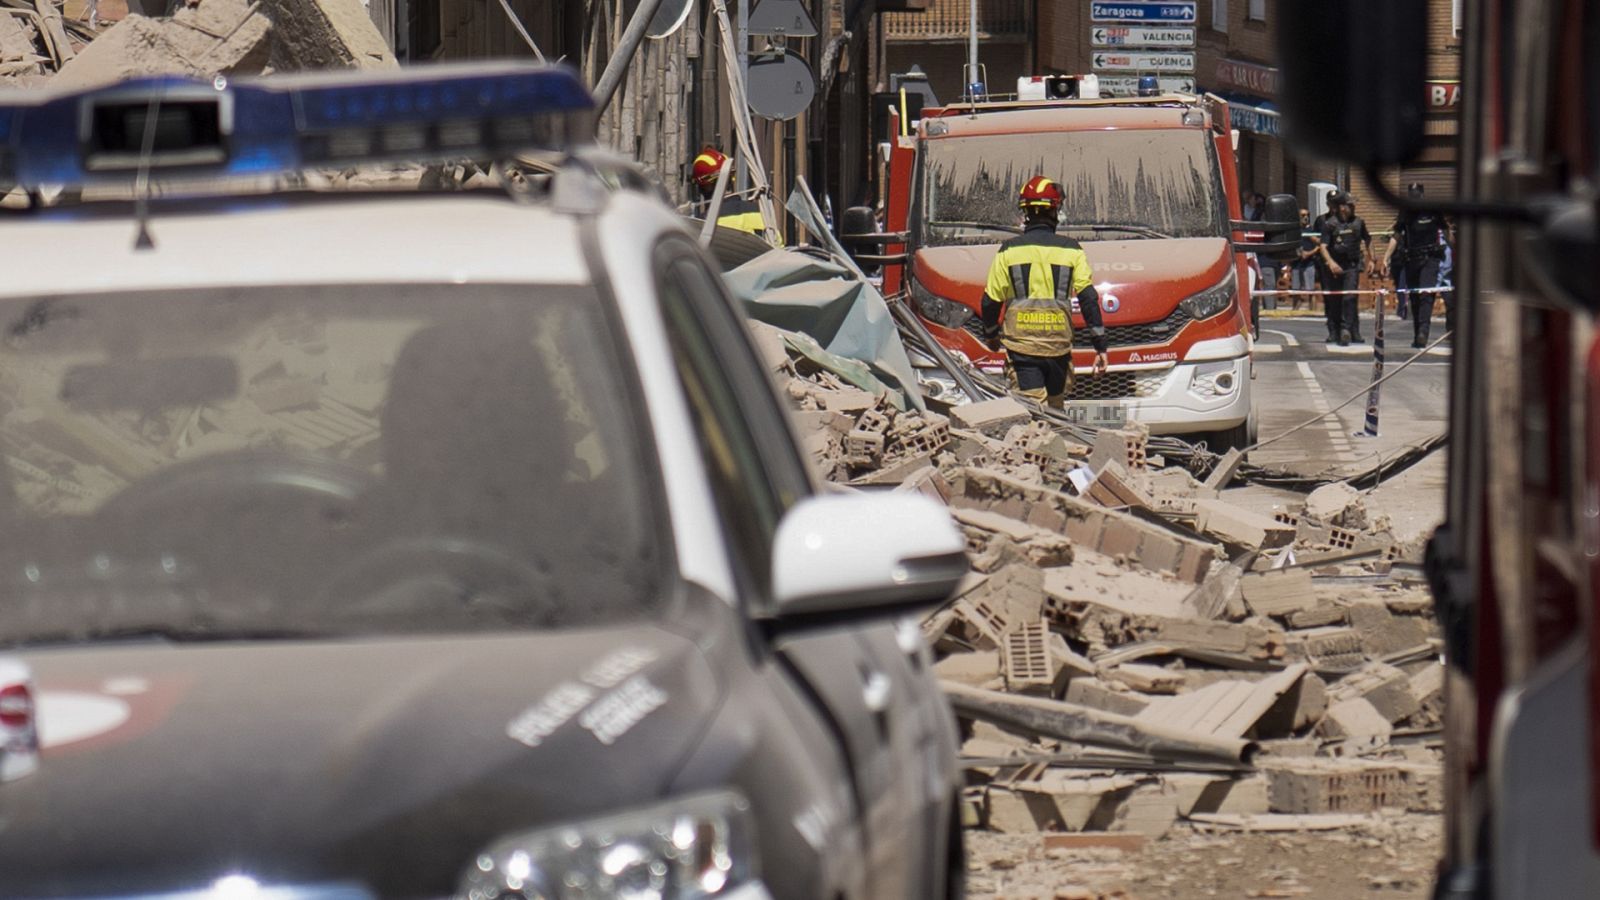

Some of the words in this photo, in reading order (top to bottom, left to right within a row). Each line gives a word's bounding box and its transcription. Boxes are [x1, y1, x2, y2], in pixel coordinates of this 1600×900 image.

[1094, 6, 1144, 18] Zaragoza
[1142, 33, 1192, 41] VALENCIA
[1150, 57, 1192, 66] CUENCA
[1431, 85, 1460, 106] BA
[1093, 262, 1144, 272] ROS
[1142, 352, 1178, 362] MAGIRUS
